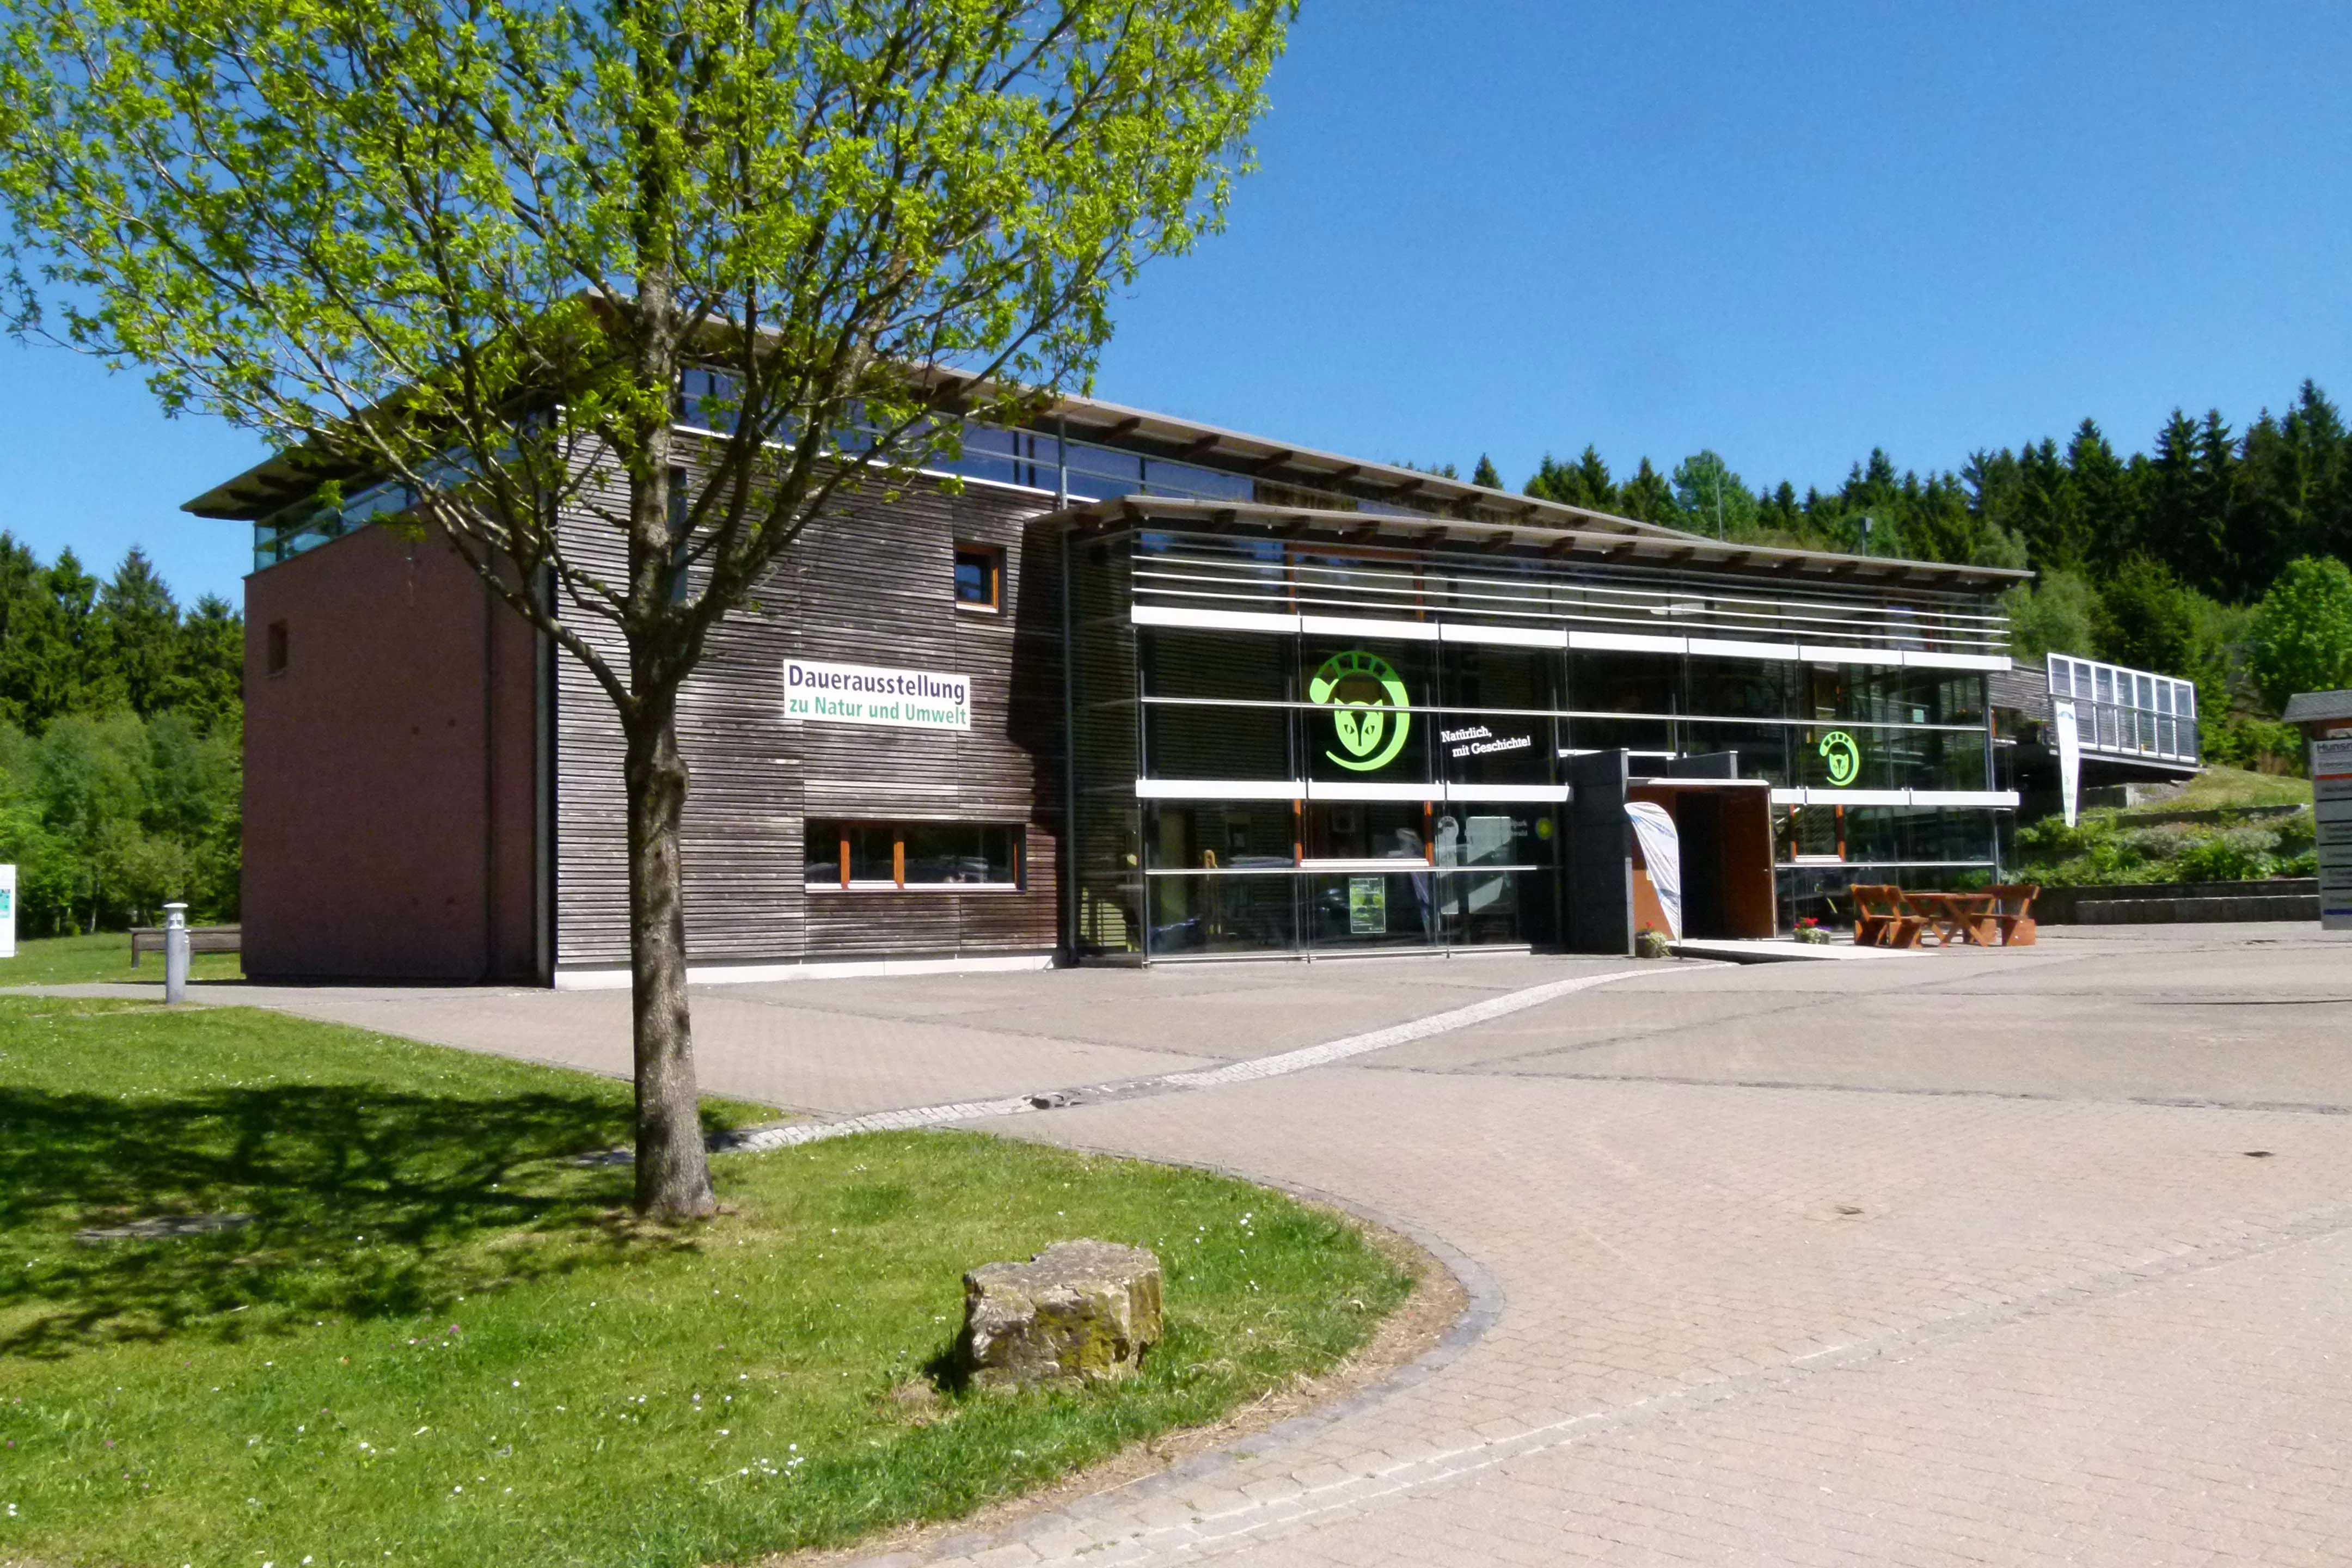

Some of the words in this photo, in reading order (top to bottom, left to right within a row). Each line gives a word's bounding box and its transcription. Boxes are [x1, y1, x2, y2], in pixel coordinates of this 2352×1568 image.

[789, 665, 965, 706] Dauerausstellung
[789, 699, 808, 713] zu
[815, 696, 862, 717] Natur
[869, 702, 899, 719] und
[906, 703, 966, 725] Umwelt
[1440, 725, 1493, 743] Natürlich,
[1451, 744, 1470, 758] mit
[1471, 735, 1532, 755] Geschichte!
